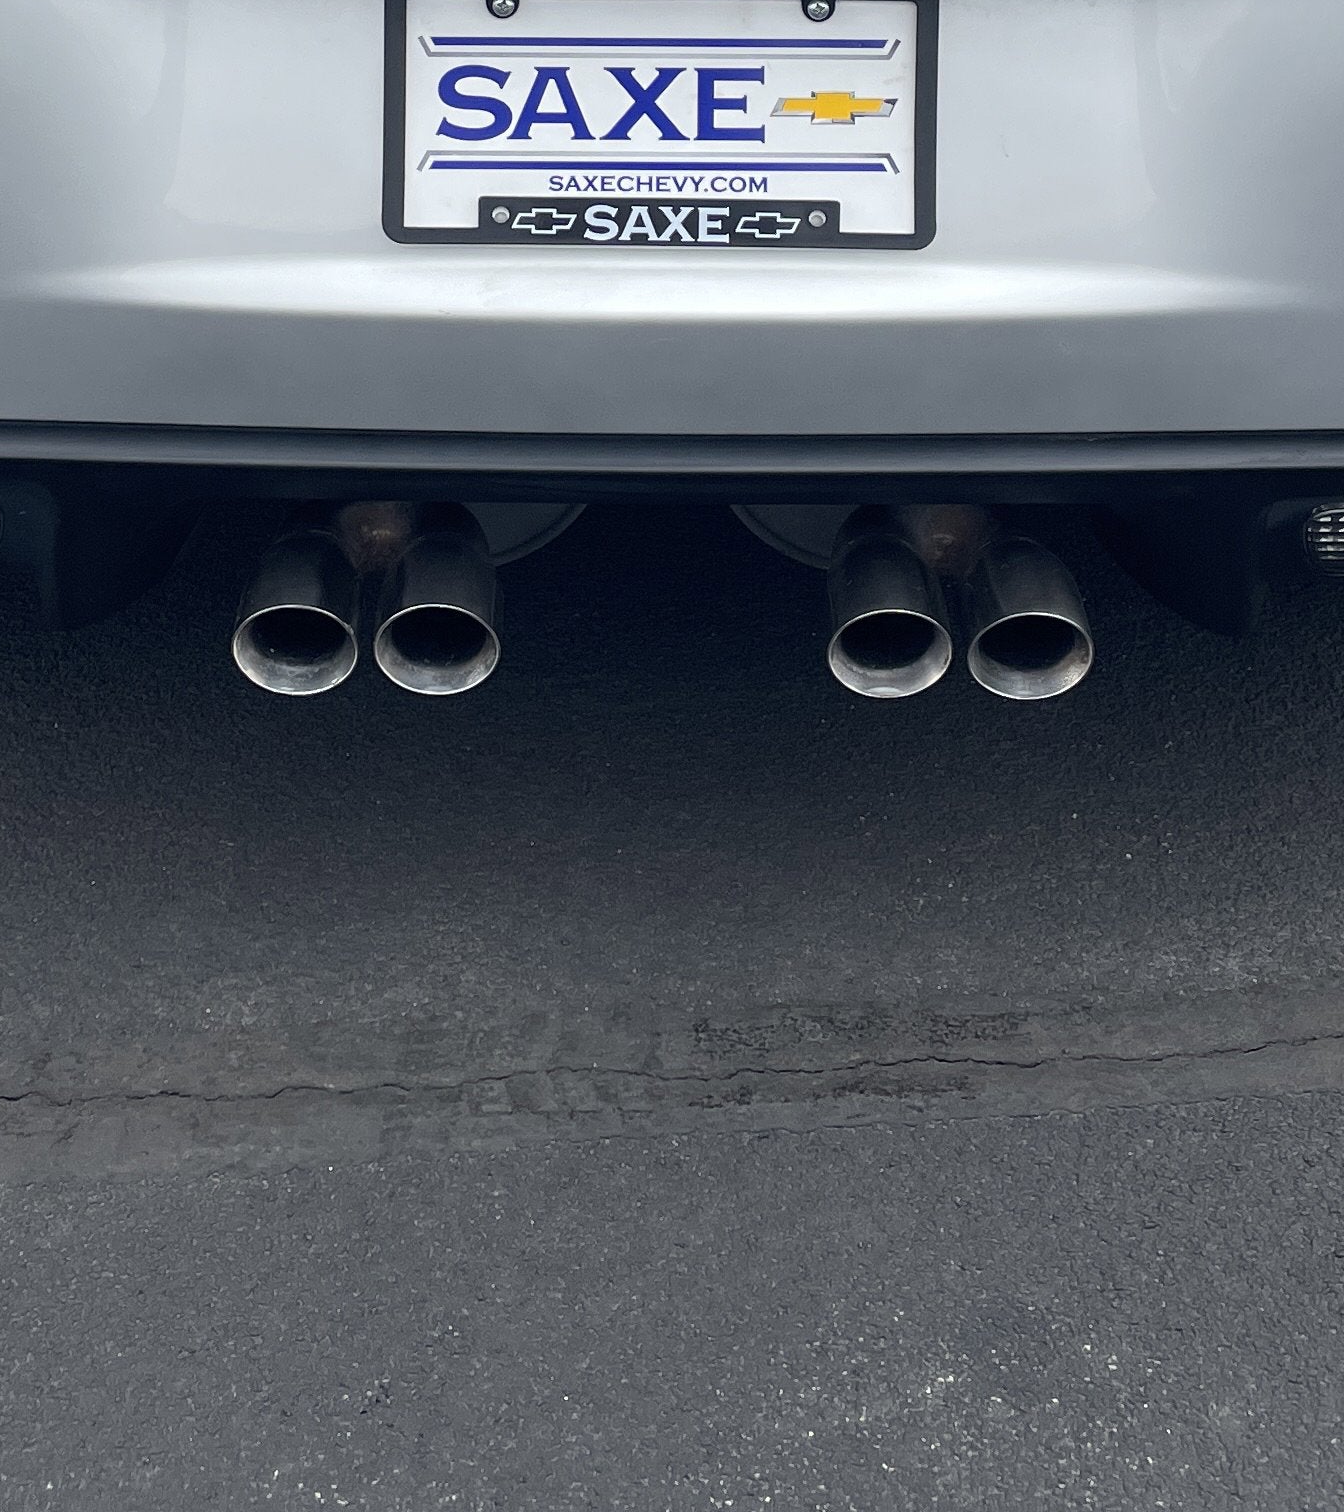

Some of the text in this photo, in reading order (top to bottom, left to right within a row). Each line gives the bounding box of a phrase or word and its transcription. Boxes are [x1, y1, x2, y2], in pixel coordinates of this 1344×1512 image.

[435, 64, 766, 144] SAXE
[548, 175, 769, 193] SAXECHEVY.COM
[583, 204, 730, 244] SAXE
